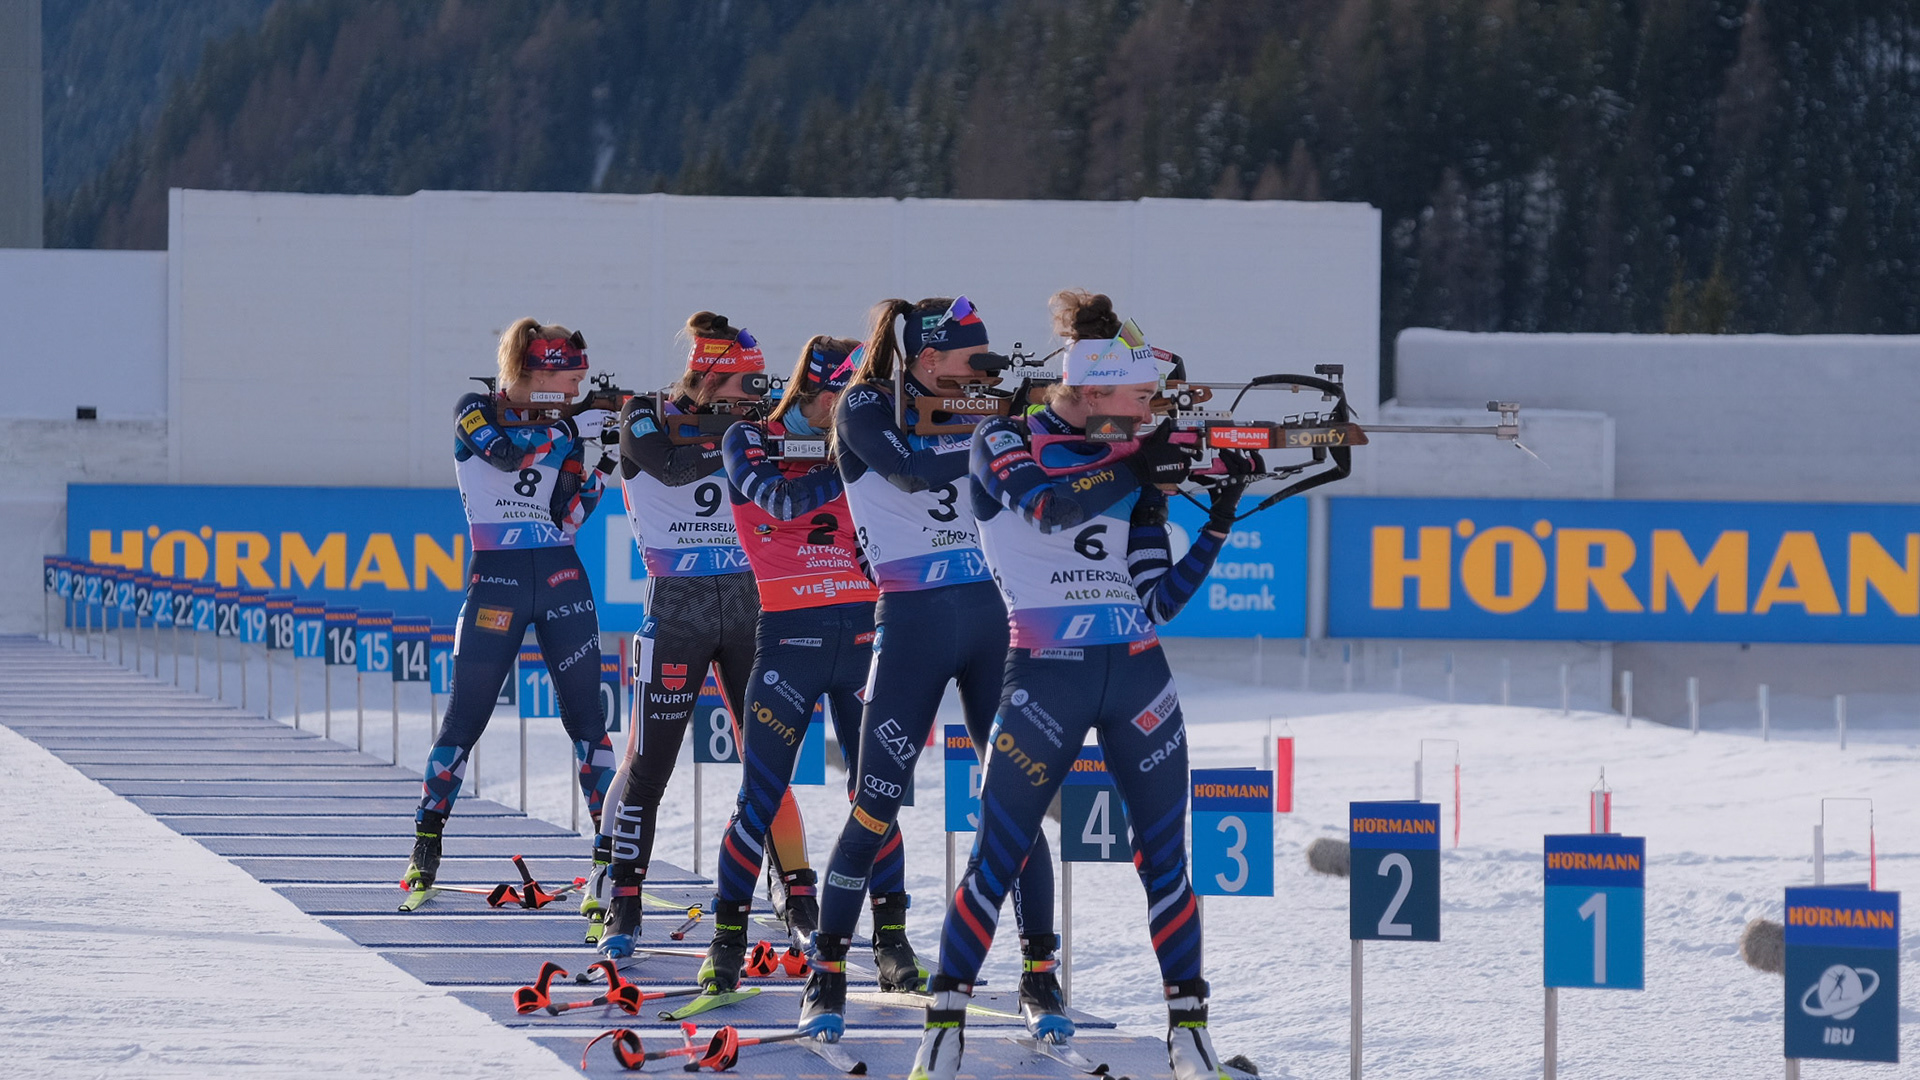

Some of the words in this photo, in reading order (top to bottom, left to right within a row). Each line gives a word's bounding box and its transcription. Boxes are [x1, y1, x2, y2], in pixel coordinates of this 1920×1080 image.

[943, 399, 998, 409] FIOCCHI
[1213, 429, 1268, 442] VIESSMANN
[1289, 429, 1345, 446] somfy
[514, 468, 542, 497] 8
[1072, 470, 1115, 493] somfy
[694, 482, 722, 517] 9
[928, 483, 958, 522] 3
[807, 514, 838, 544] 2
[1074, 524, 1109, 561] 6
[89, 524, 464, 591] HÖRMAN
[1371, 519, 1920, 616] HÖRMAN
[480, 575, 519, 586] LAPUA
[550, 571, 576, 584] MENY
[792, 578, 870, 598] VIESSMANN
[196, 599, 216, 630] 21
[1208, 583, 1276, 612] Bank
[218, 603, 240, 635] 20
[242, 607, 267, 641] 19
[269, 612, 294, 648] 18
[297, 620, 322, 656] 17
[328, 626, 357, 664] 16
[361, 632, 389, 671] 15
[558, 638, 595, 671] CRAFT
[1041, 648, 1062, 656] Jean
[1063, 649, 1083, 657] Lain
[396, 640, 428, 680] 14
[435, 651, 455, 692] 1
[526, 671, 552, 716] 11
[650, 692, 694, 704] WÜRTH
[709, 707, 734, 761] 8
[750, 701, 797, 746] somfy
[878, 718, 917, 761] EA7
[1021, 706, 1063, 748] Rhône-Alpes
[997, 732, 1050, 787] omfy
[1139, 724, 1186, 773] CRAFT
[864, 788, 878, 800] Audi
[1194, 784, 1269, 798] HÖRMANN
[612, 800, 643, 860] GER
[1081, 791, 1117, 859] 4
[1353, 817, 1435, 834] HÖRMANN
[1215, 815, 1249, 893] 3
[1547, 851, 1640, 871] HÖRMANN
[1378, 852, 1413, 937] 2
[1788, 906, 1895, 930] HÖRMANN
[1577, 892, 1607, 984] 1
[1822, 1027, 1855, 1045] IBU
